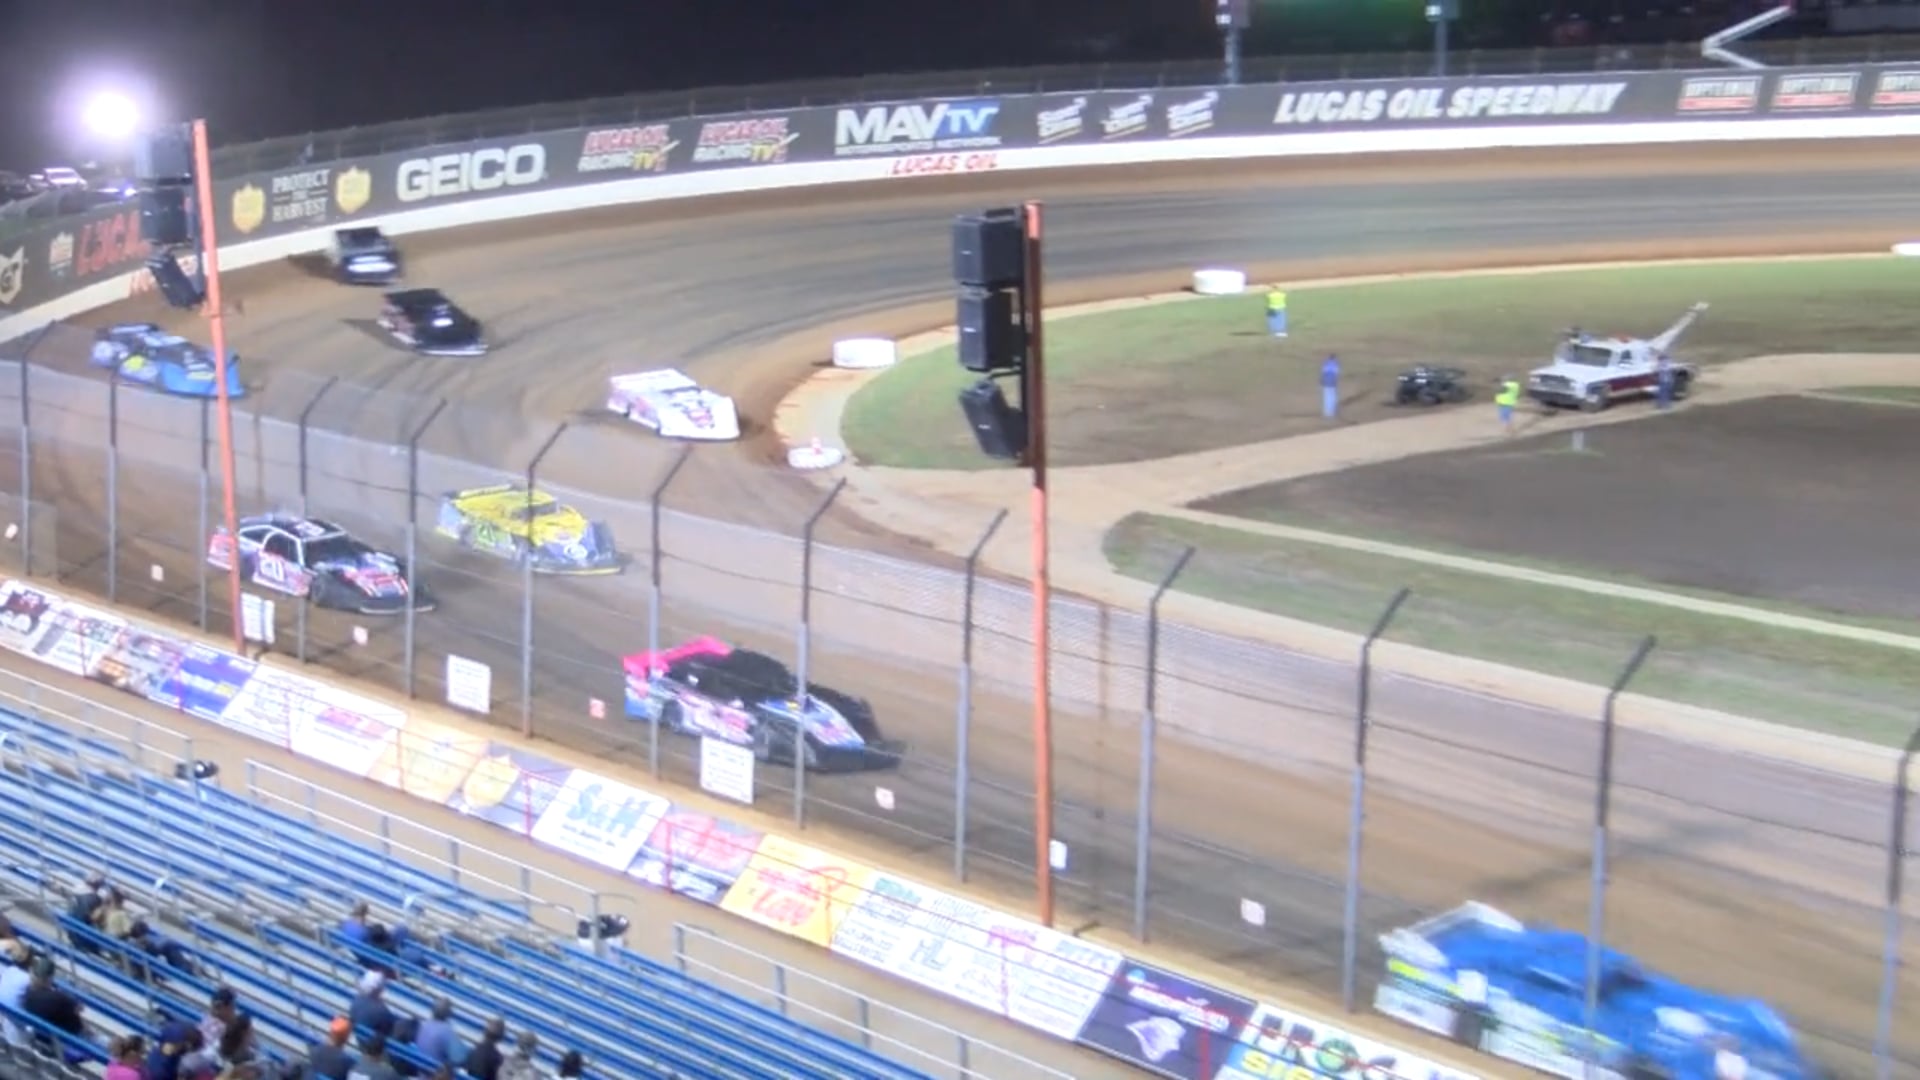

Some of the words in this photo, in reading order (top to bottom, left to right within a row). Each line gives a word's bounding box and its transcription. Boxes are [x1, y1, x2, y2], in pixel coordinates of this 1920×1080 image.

[1273, 89, 1387, 124] LUCAS
[1387, 88, 1443, 119] OIL
[1447, 82, 1628, 118] SPEEDWAY
[397, 144, 545, 202] GEICO
[892, 155, 960, 175] LUCAS
[965, 153, 998, 170] OIL
